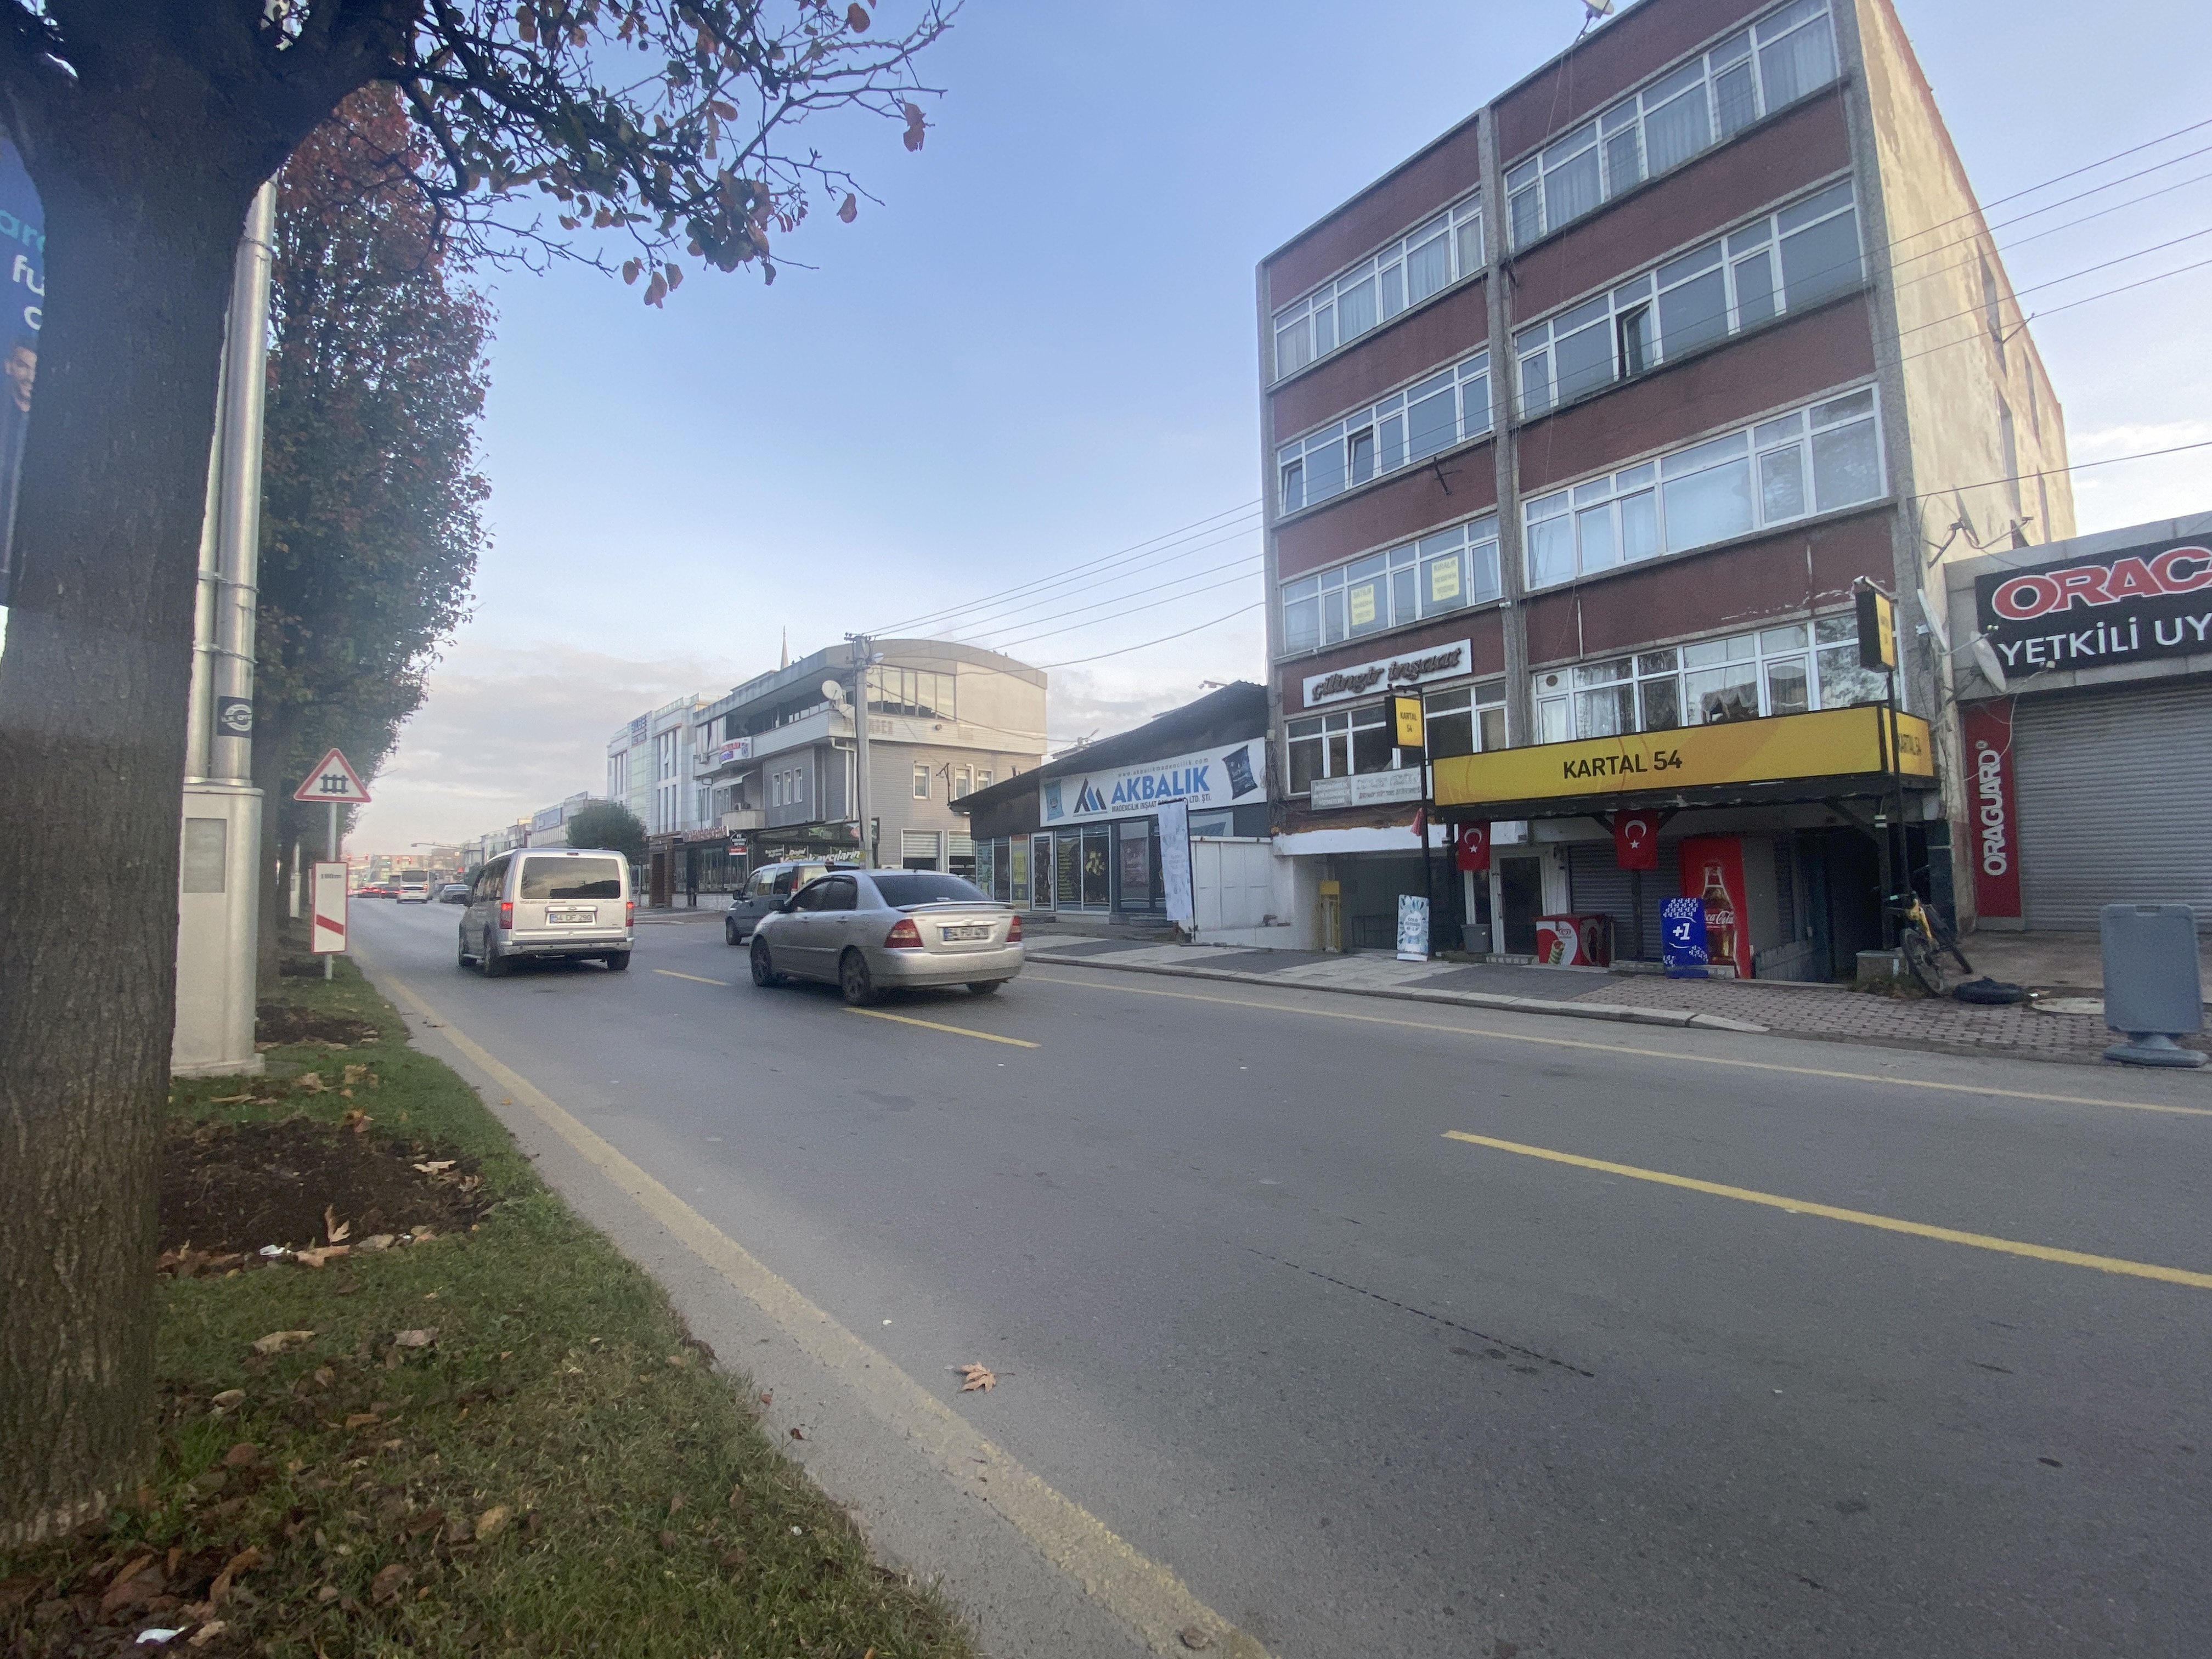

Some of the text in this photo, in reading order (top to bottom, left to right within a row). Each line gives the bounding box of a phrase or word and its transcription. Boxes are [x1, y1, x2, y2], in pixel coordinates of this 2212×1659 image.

[1992, 546, 2212, 620] ORAC
[1997, 617, 2139, 666] YETKİLİ
[1400, 712, 1417, 721] KARTAL
[1564, 749, 1683, 779] KARTAL 54
[1111, 765, 1210, 804] AKBALIK
[1978, 749, 2007, 876] ORAGUARD
[1673, 923, 1690, 940] +1
